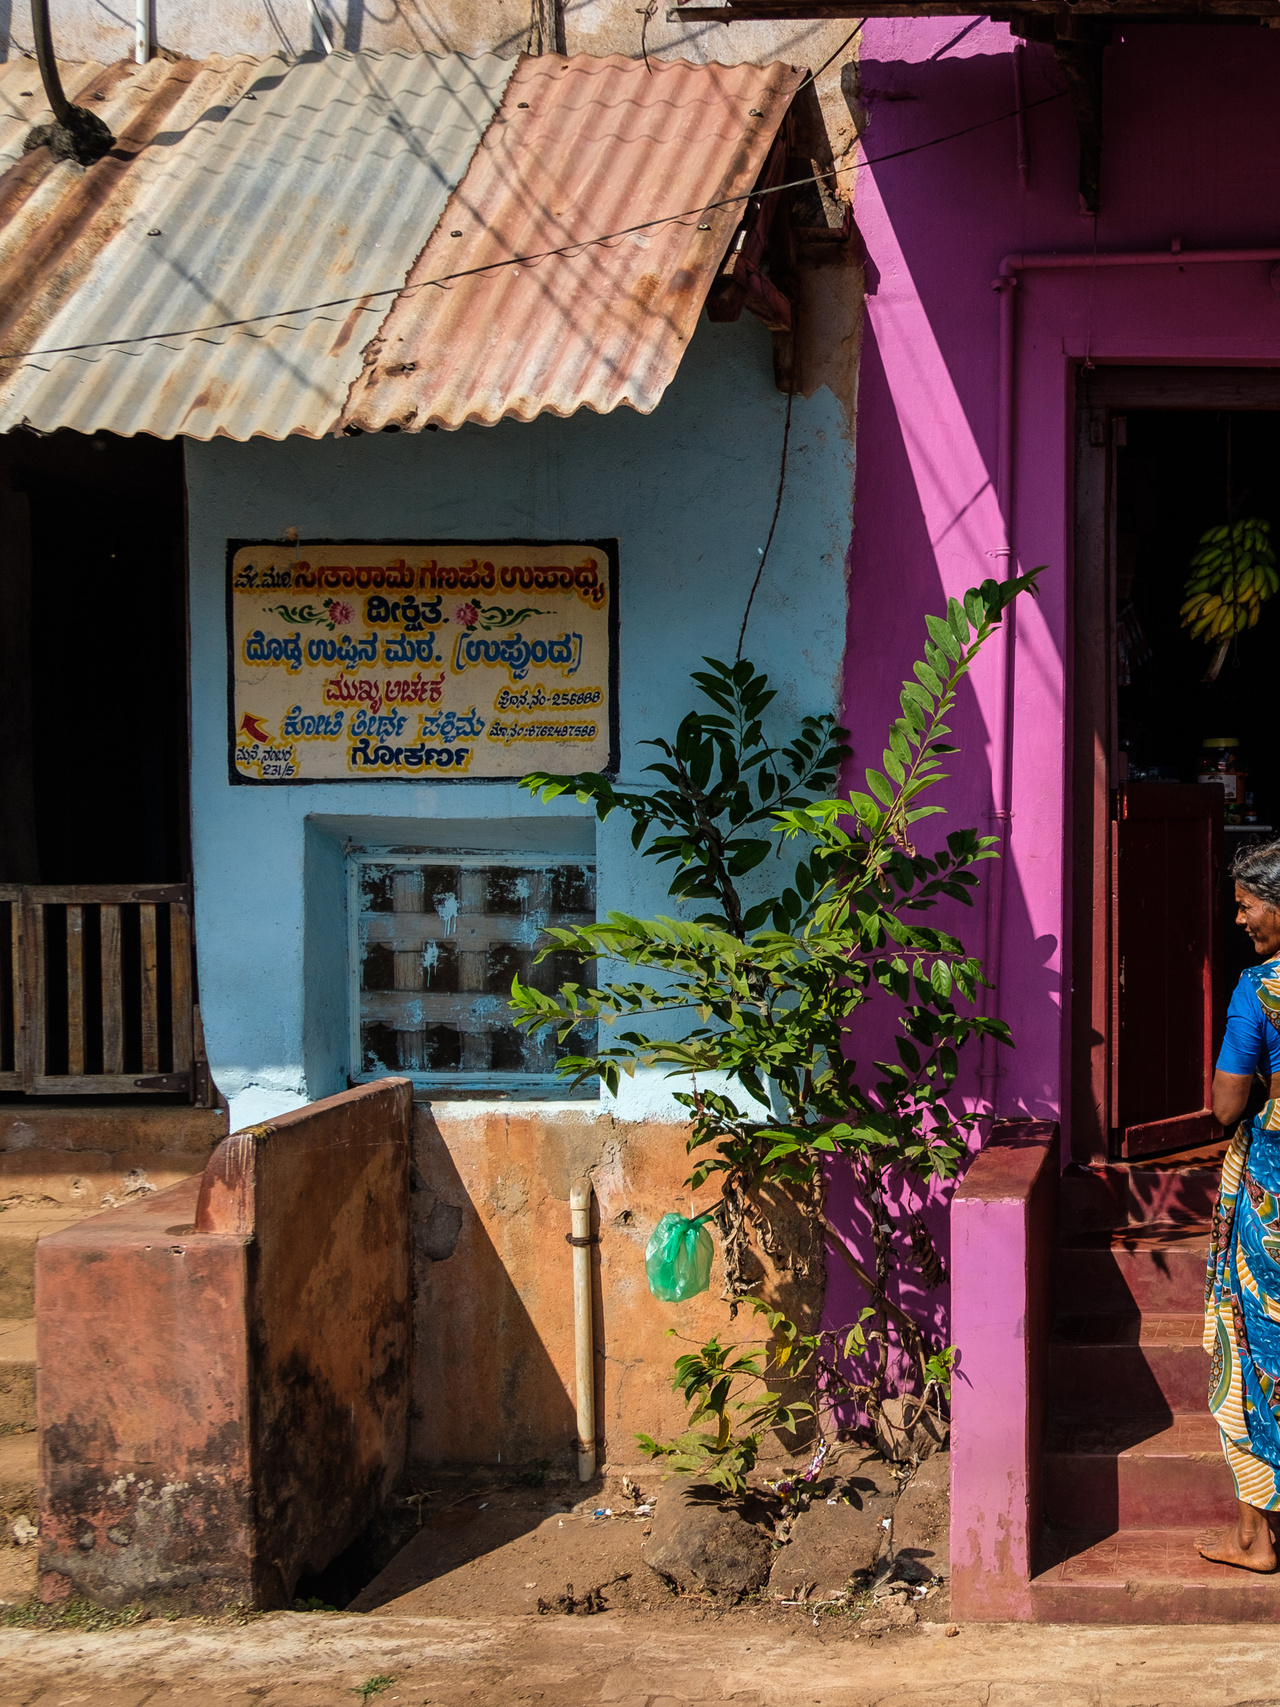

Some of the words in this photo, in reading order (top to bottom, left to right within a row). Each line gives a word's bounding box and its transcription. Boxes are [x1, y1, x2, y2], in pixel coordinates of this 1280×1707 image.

[420, 559, 496, 589] ಗಣಪತಿ
[284, 705, 345, 737] ಕೋಟಿ
[352, 738, 470, 767] ಗೋಕರ್ಣ
[262, 764, 295, 779] 231/5
